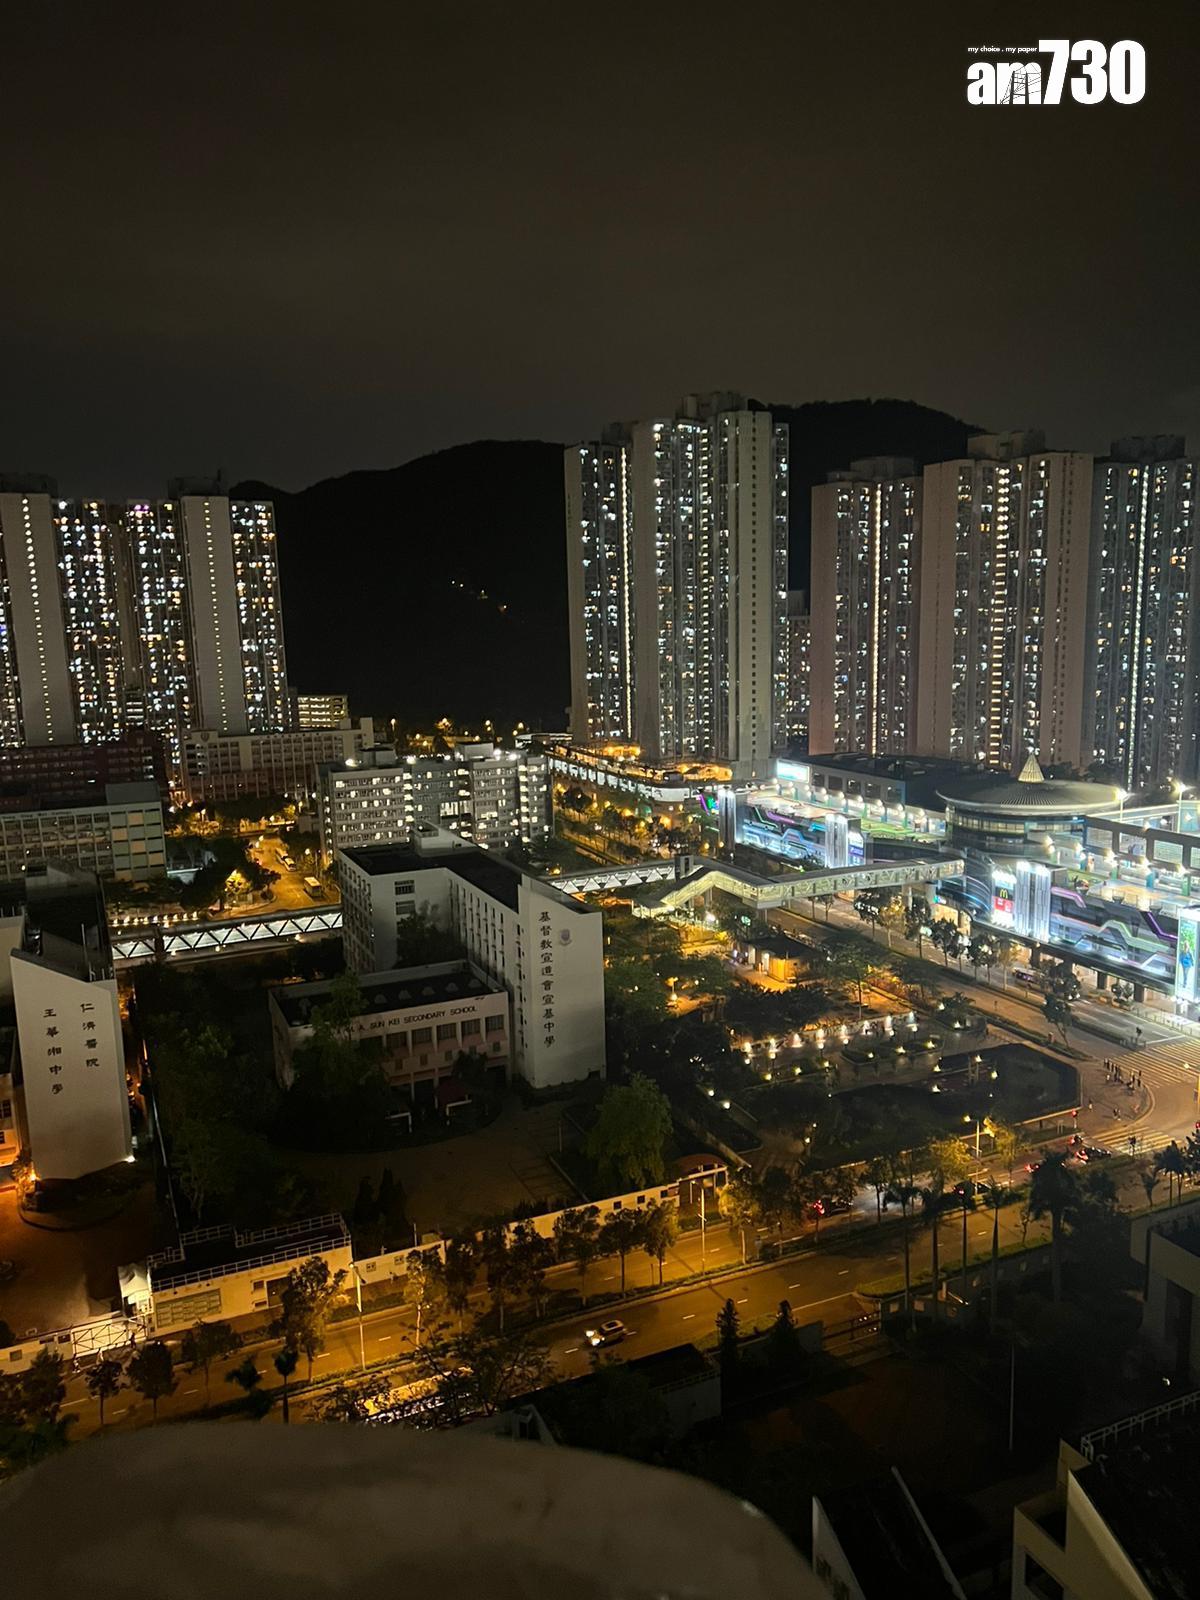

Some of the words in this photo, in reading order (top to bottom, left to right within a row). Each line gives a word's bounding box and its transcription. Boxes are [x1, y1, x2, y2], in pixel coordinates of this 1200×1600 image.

[369, 1020, 385, 1029] SUN
[388, 1017, 400, 1027] KEI
[403, 1010, 446, 1024] SECONDARY
[450, 1005, 477, 1016] SCHOOL
